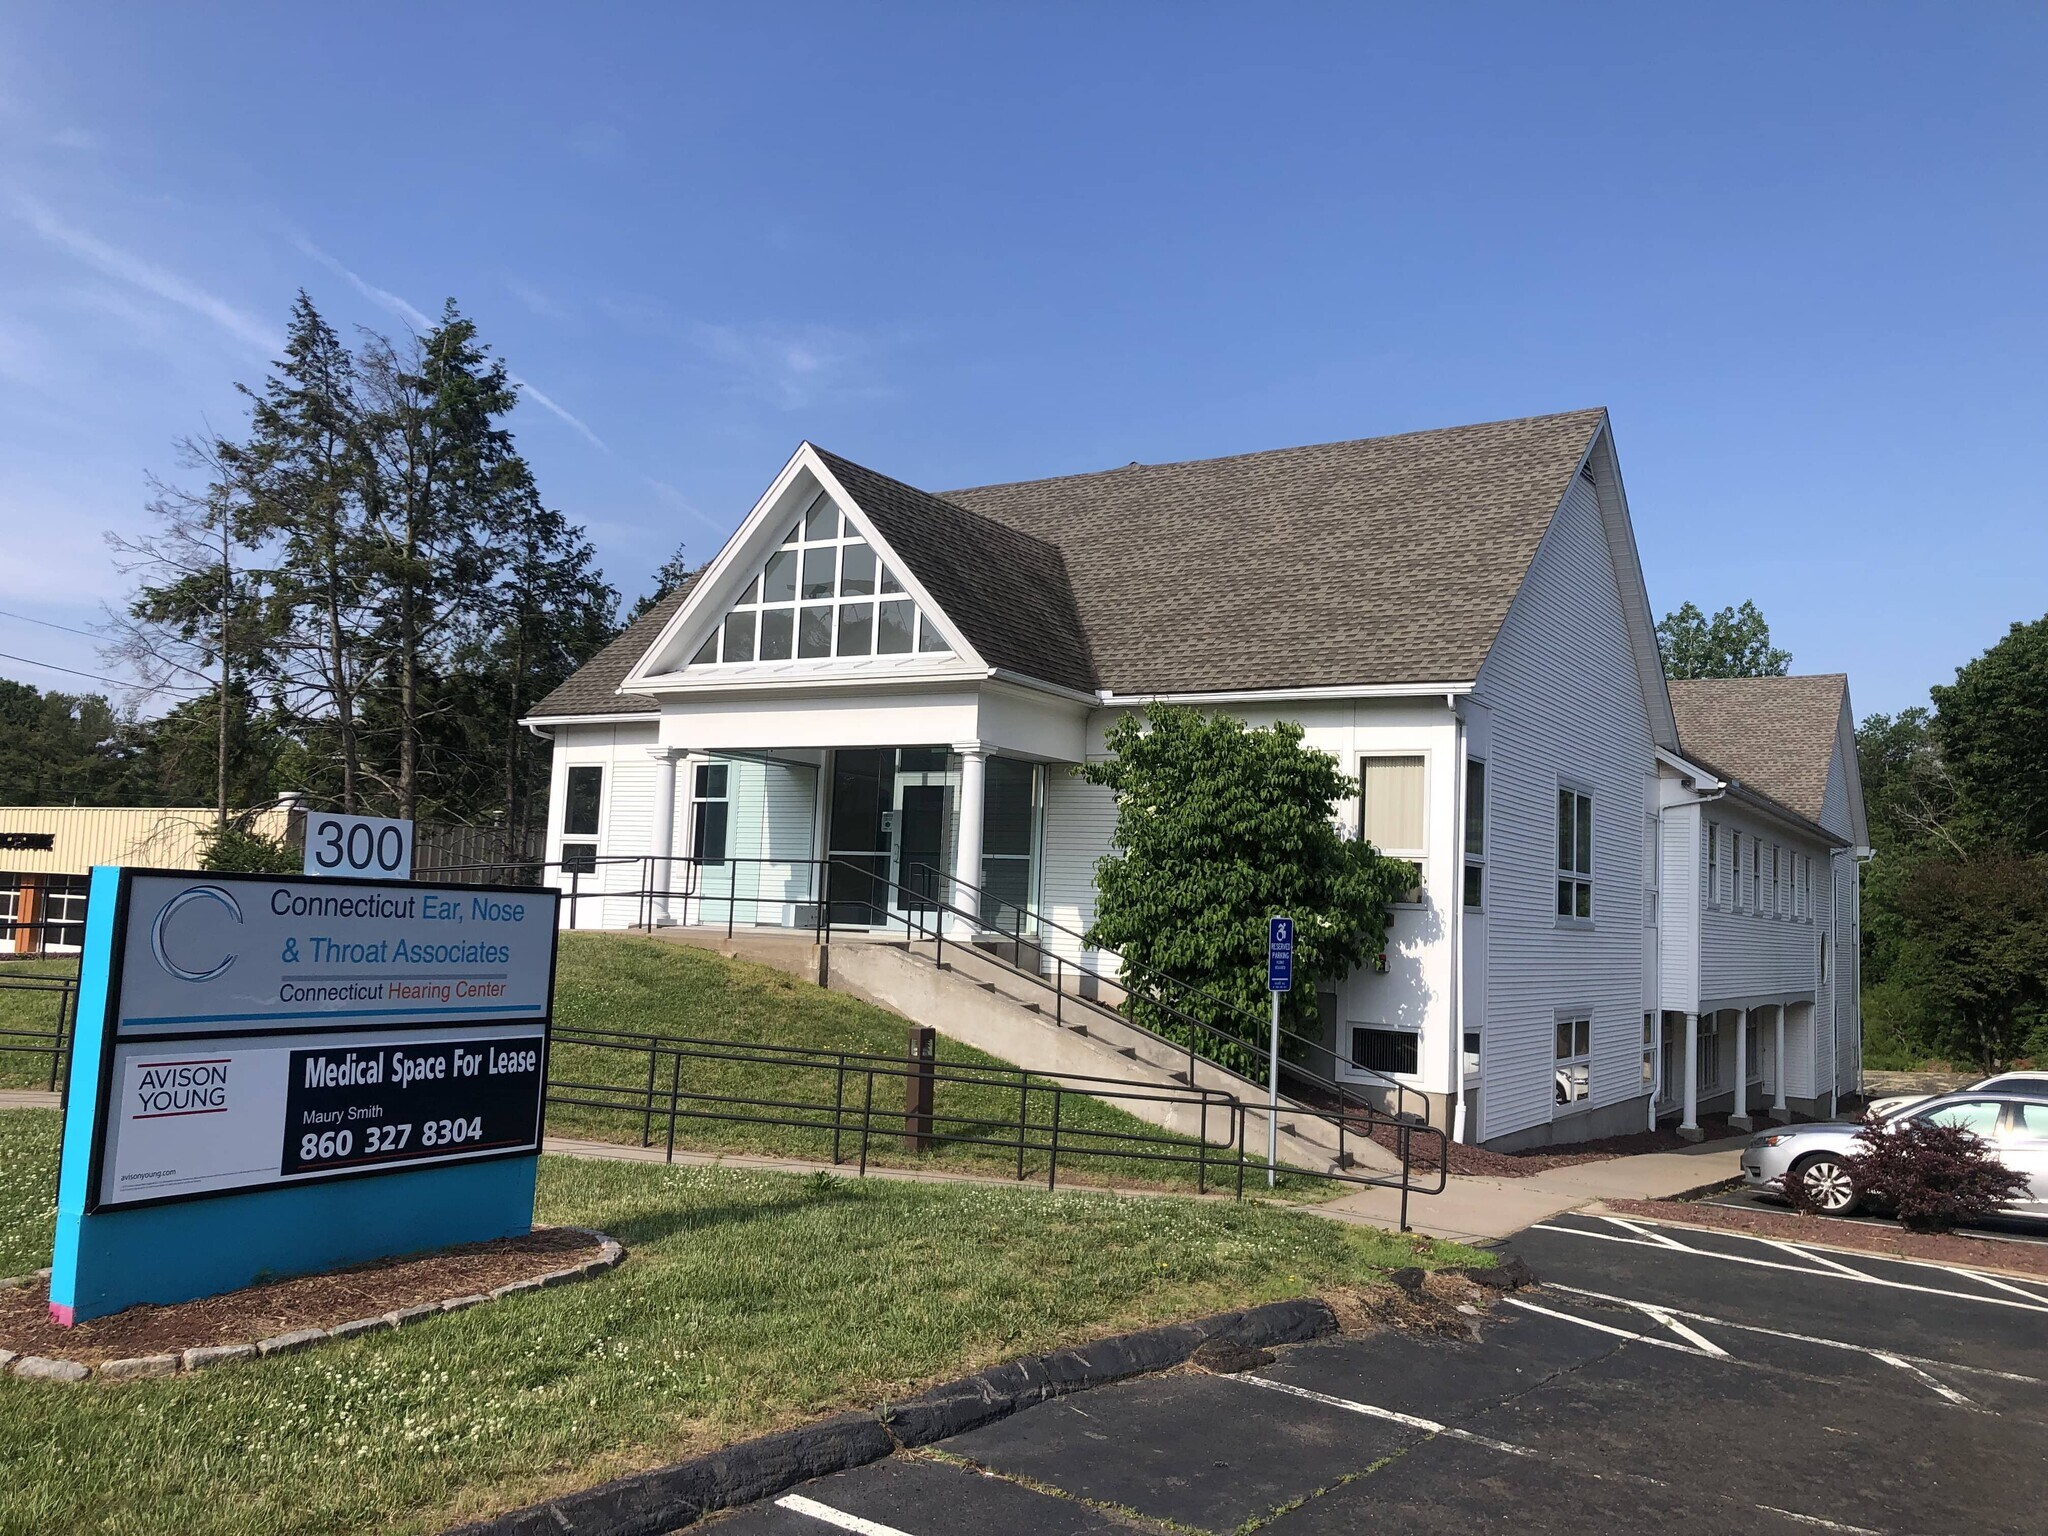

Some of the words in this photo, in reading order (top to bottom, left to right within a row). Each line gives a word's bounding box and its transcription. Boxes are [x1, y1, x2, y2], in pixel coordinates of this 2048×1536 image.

[315, 820, 403, 871] 300
[270, 888, 416, 919] Connecticut
[422, 895, 463, 924] Ear,
[471, 897, 525, 922] Nose
[281, 937, 299, 963] &
[309, 937, 387, 963] Throat
[392, 938, 510, 963] Associates
[279, 983, 383, 1002] Connecticut
[388, 982, 450, 1002] Hearing
[455, 980, 506, 997] Center
[138, 1066, 227, 1090] AVISON
[304, 1051, 384, 1088] Medical
[391, 1051, 446, 1089] Space
[453, 1048, 482, 1077] For
[488, 1047, 536, 1075] Lease
[138, 1087, 226, 1112] YOUNG
[302, 1109, 344, 1125] Maury
[347, 1105, 383, 1120] Smith
[300, 1130, 353, 1160] 860
[364, 1124, 412, 1154] 327
[421, 1116, 482, 1146] 8304
[120, 1169, 177, 1181] avisonyoung.com
